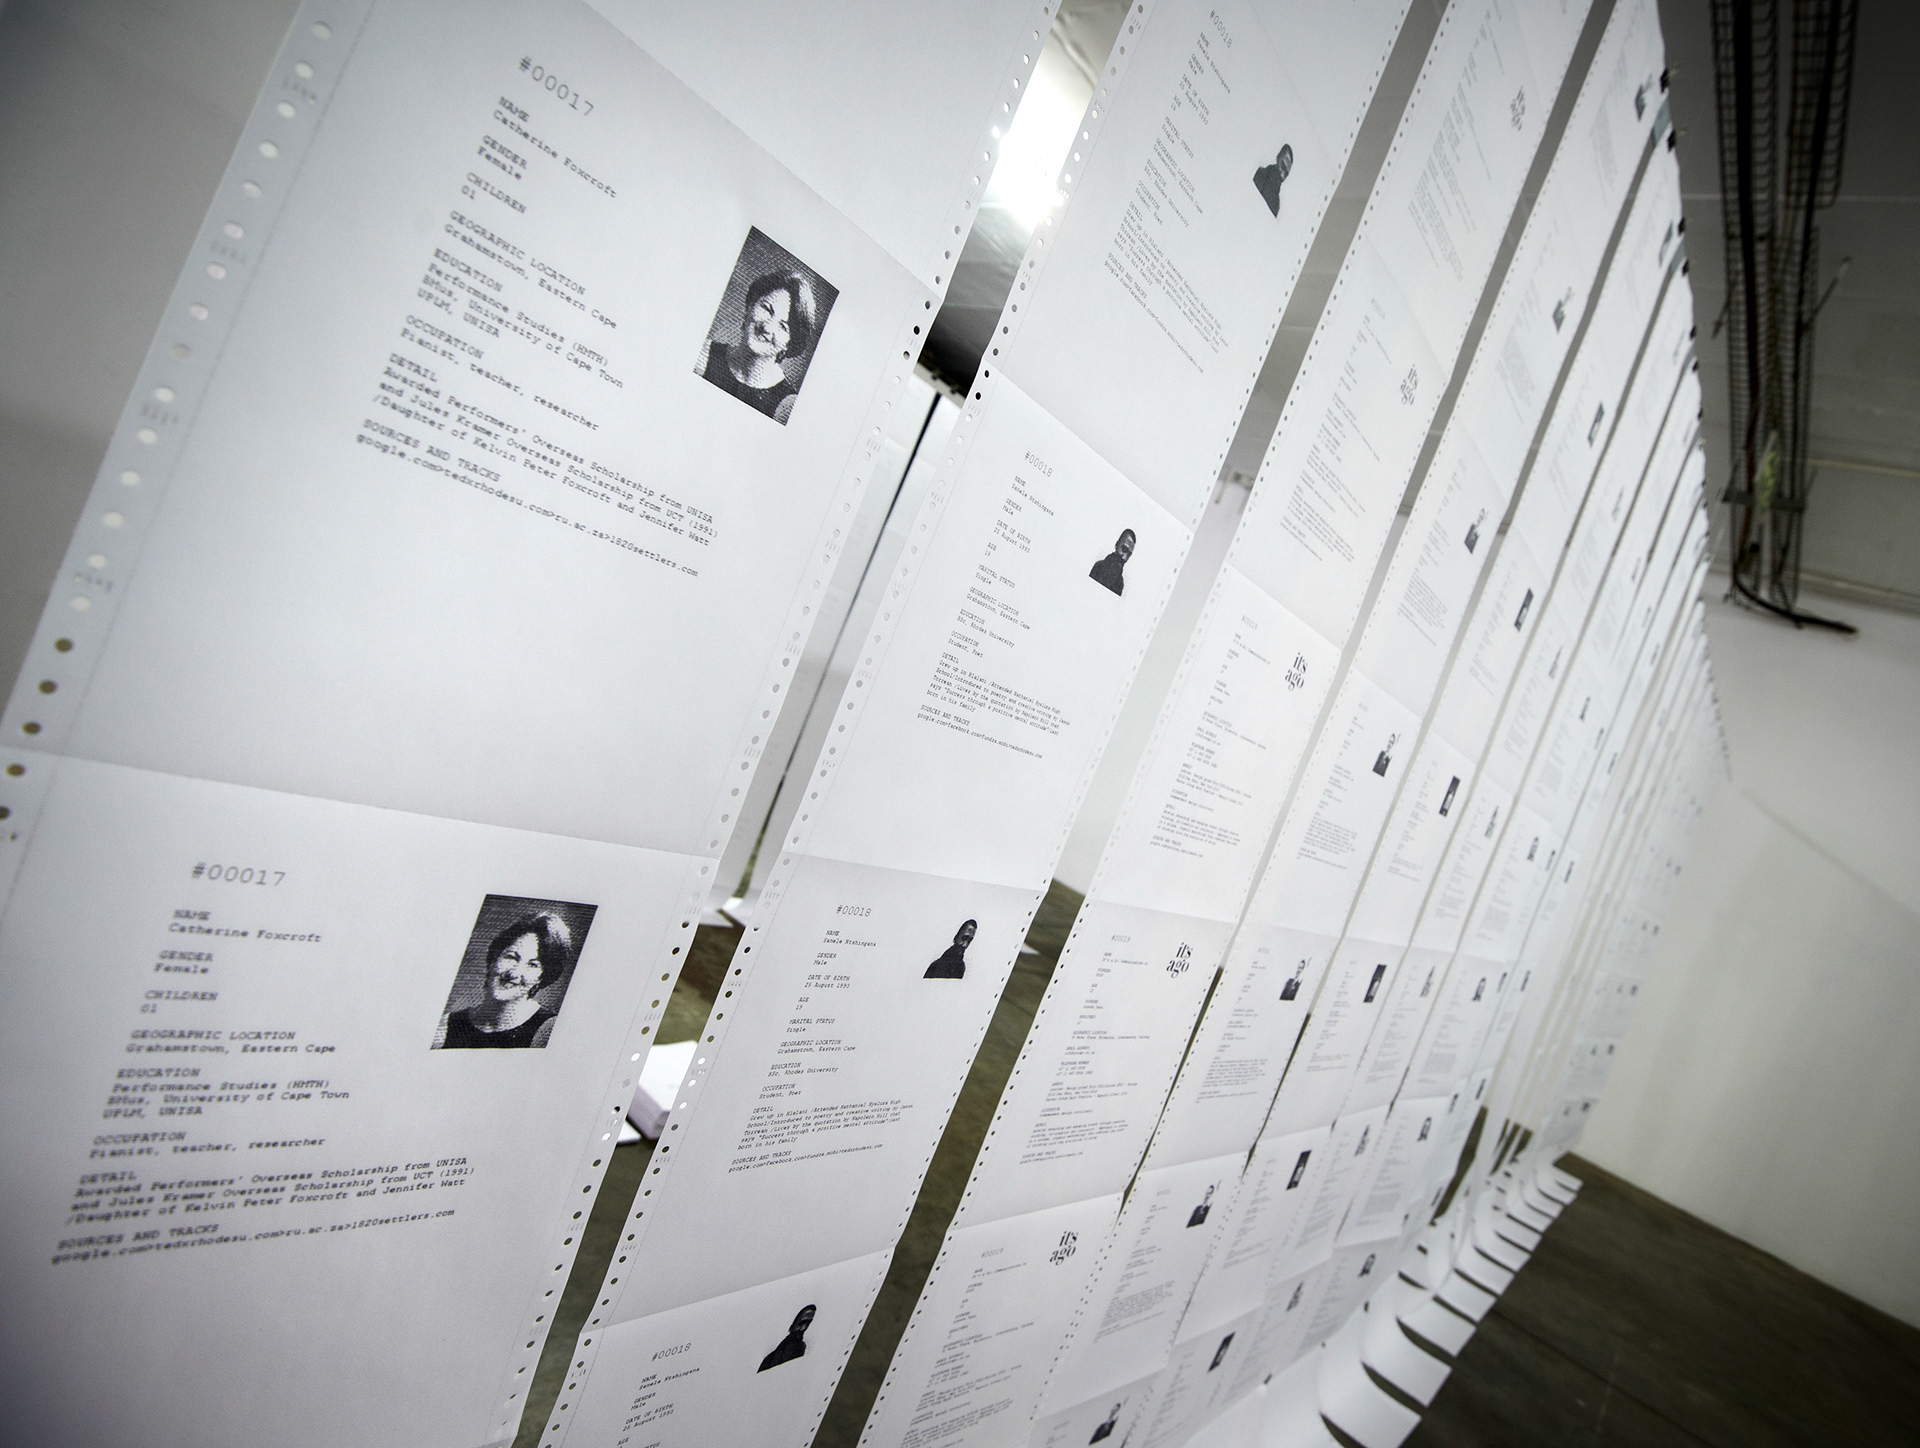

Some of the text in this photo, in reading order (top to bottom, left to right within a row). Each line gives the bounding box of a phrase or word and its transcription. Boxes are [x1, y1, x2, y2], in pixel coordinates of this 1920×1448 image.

[1209, 10, 1232, 48] #00018
[519, 56, 593, 115] #00017
[499, 96, 529, 122] NAME
[477, 146, 521, 179] Female
[483, 135, 526, 168] GENDER
[494, 110, 616, 197] Catherine Foxcroft
[461, 184, 475, 199] 01
[467, 172, 526, 213] CHILDREN
[434, 248, 502, 291] EDUCATION
[450, 211, 585, 294] GEOGRAPHIC LOCATION
[428, 263, 607, 366] Performance Studies (HMTH)
[538, 278, 585, 311] Eastern
[591, 309, 616, 328] Cape
[406, 315, 483, 358] OCCUPATION
[463, 312, 499, 337] UNISA
[469, 299, 540, 344] University
[545, 342, 561, 354] of
[566, 352, 591, 371] Cape
[599, 368, 623, 388] Town
[389, 353, 436, 382] DETAIL
[534, 395, 598, 430] researcher
[363, 419, 500, 482] SOURCES AND TRACKS
[379, 382, 717, 537] and Jules Kramer Overseas Scholarship from UCT (1991)
[383, 366, 440, 398] Awarded
[532, 434, 583, 464] Overseas
[590, 461, 654, 496] Scholarship
[659, 493, 682, 509] from
[686, 506, 712, 523] UNISA
[1024, 451, 1052, 477] #00018
[450, 429, 467, 440] of
[473, 436, 515, 461] Kelvin
[523, 458, 555, 478] Peter
[562, 475, 610, 503] Foxcroft
[617, 501, 634, 513] and
[639, 510, 683, 534] Jennifer
[688, 531, 709, 546] Watt
[836, 905, 871, 917] #00018
[651, 1342, 691, 1361] #00018
